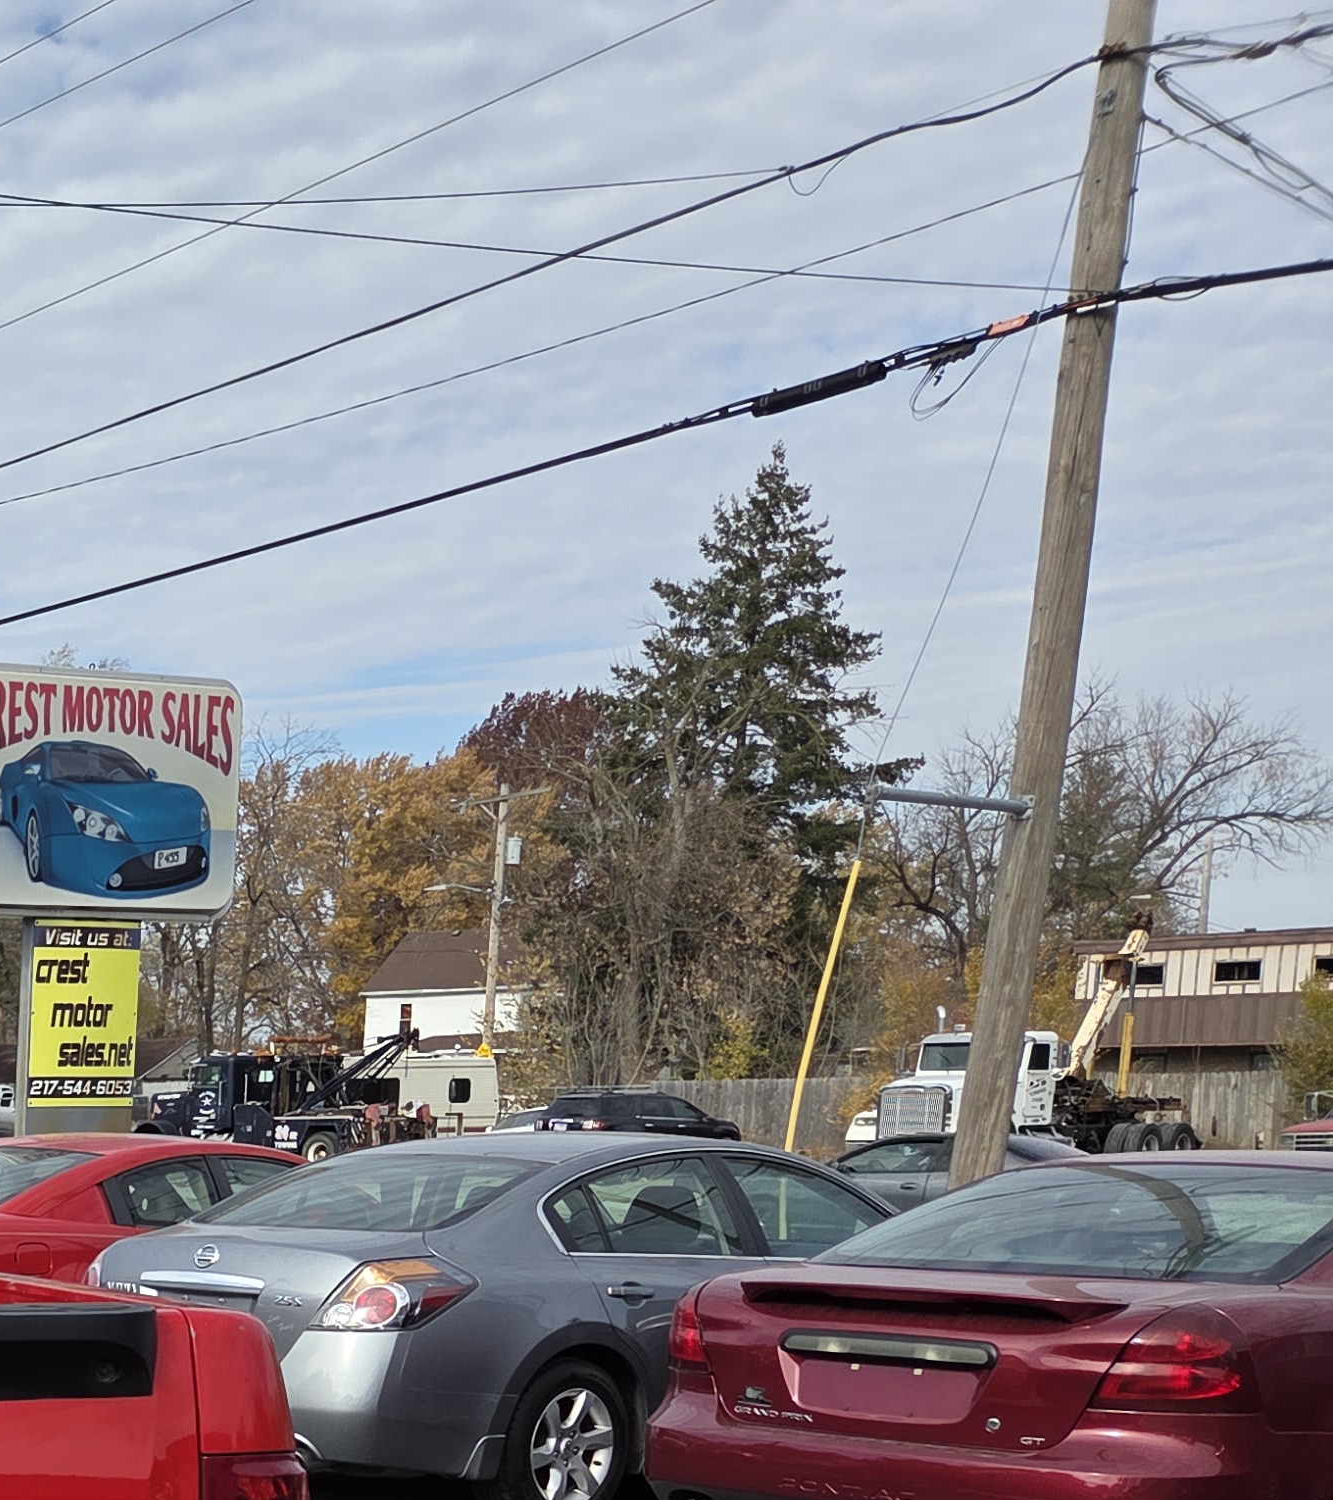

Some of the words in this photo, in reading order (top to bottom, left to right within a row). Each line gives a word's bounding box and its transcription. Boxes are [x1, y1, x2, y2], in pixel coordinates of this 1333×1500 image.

[62, 685, 155, 740] MOTOR
[160, 690, 235, 777] SALES
[45, 928, 83, 946] Visit
[86, 932, 109, 947] us
[113, 932, 133, 947] at:
[35, 952, 90, 984] crest
[50, 996, 113, 1028] motor
[57, 1035, 134, 1067] sales.net
[30, 1079, 133, 1096] 217-544-6053
[734, 1405, 779, 1418] GRAND
[1020, 1436, 1046, 1446] GT
